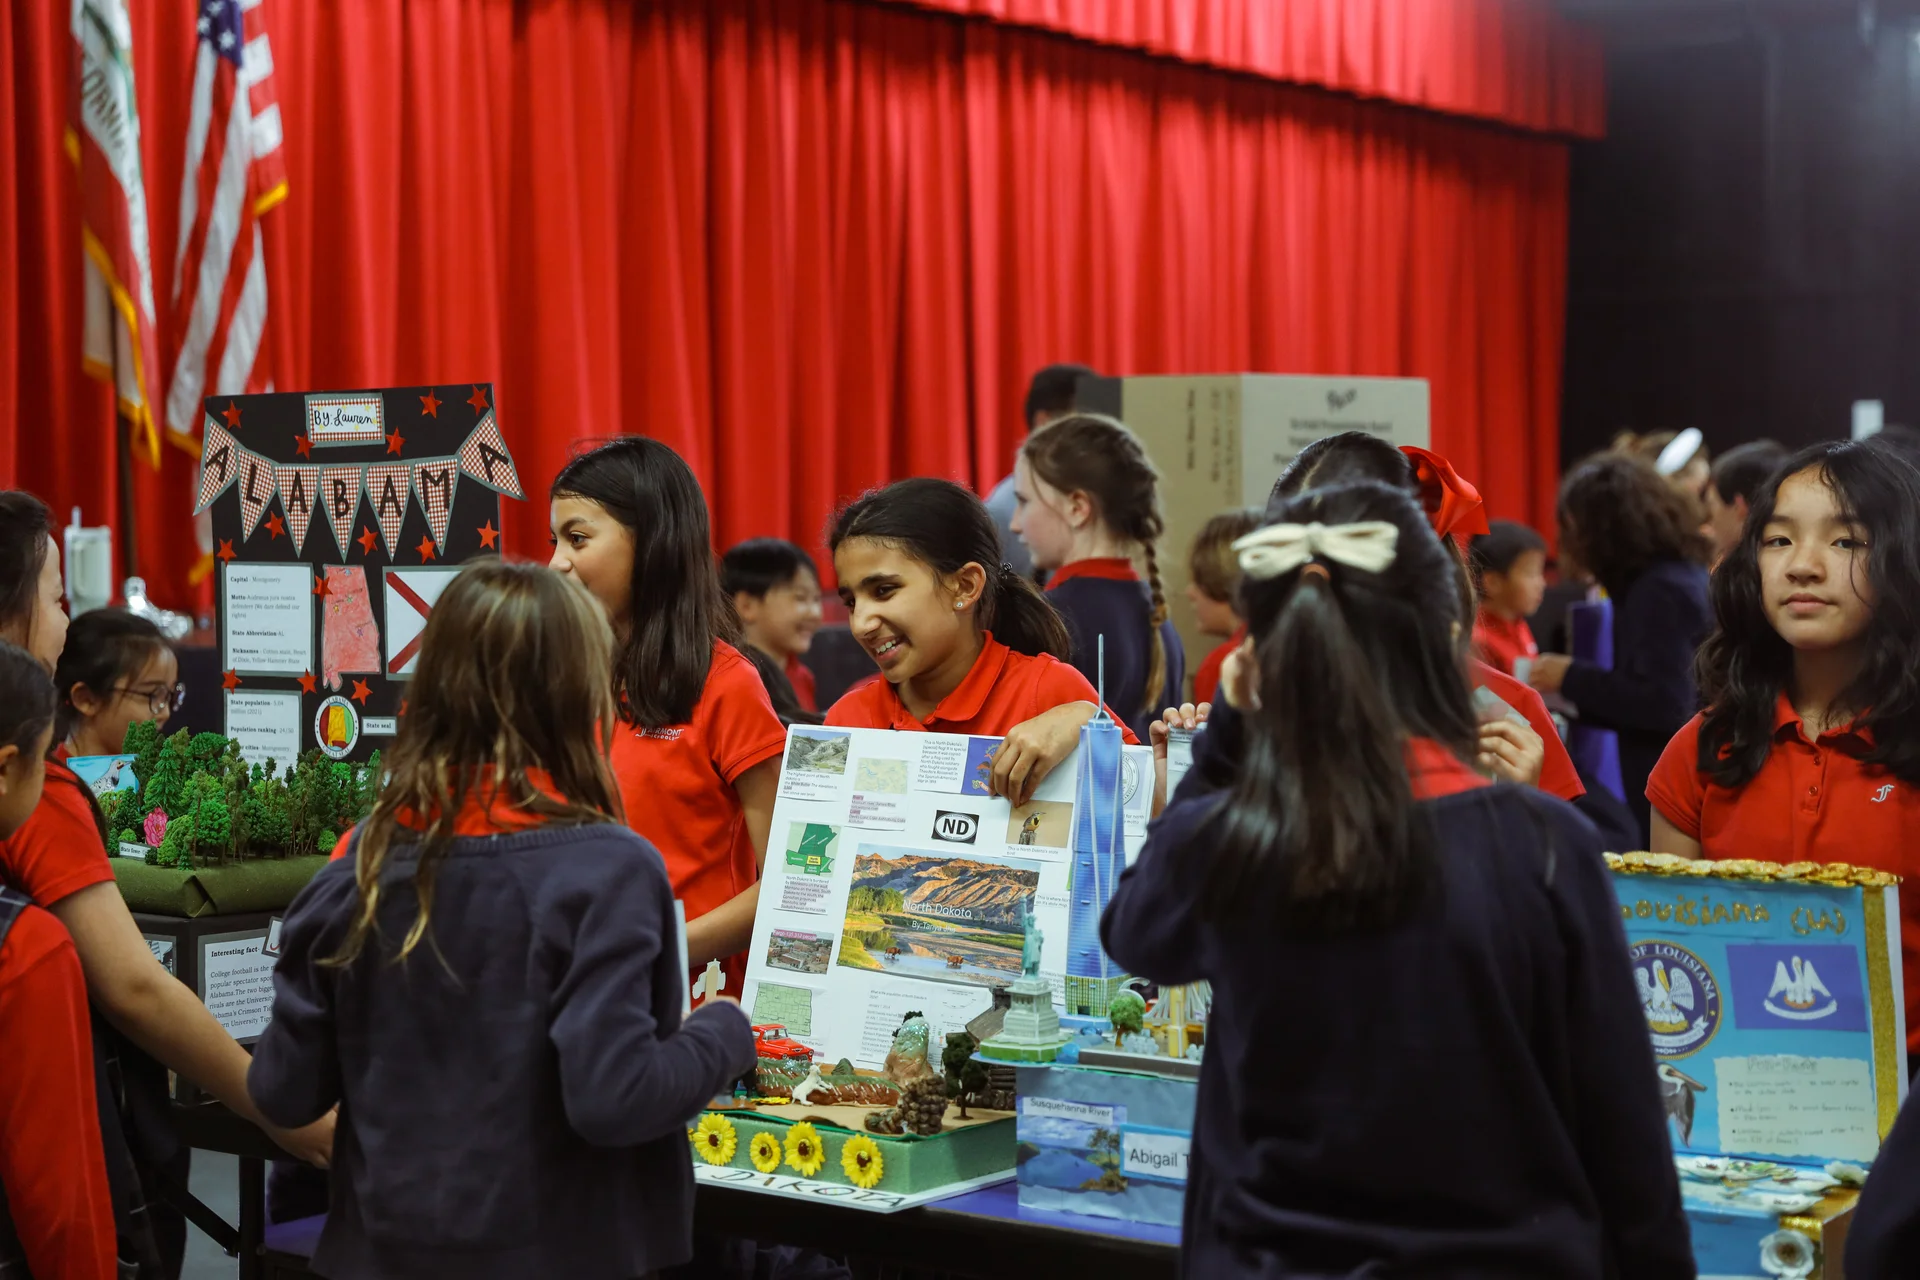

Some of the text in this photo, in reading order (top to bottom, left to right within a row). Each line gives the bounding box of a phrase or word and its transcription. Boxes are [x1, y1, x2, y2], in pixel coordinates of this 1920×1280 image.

[334, 408, 373, 427] Lauren
[205, 441, 508, 519] ALABAMA
[942, 818, 970, 836] ND
[902, 900, 972, 918] North Dakota
[1620, 894, 1770, 926] ouisiana
[211, 948, 245, 957] Interesting
[210, 970, 230, 978] College
[231, 967, 253, 976] football
[1654, 944, 1716, 1000] LOUISIANA
[210, 980, 232, 990] popular
[233, 976, 259, 986] spectator
[209, 1001, 224, 1010] rivals
[238, 1007, 262, 1015] Crimson
[231, 1017, 258, 1027] University
[1030, 1098, 1112, 1118] Susquehanna River
[1130, 1148, 1178, 1169] Abigail
